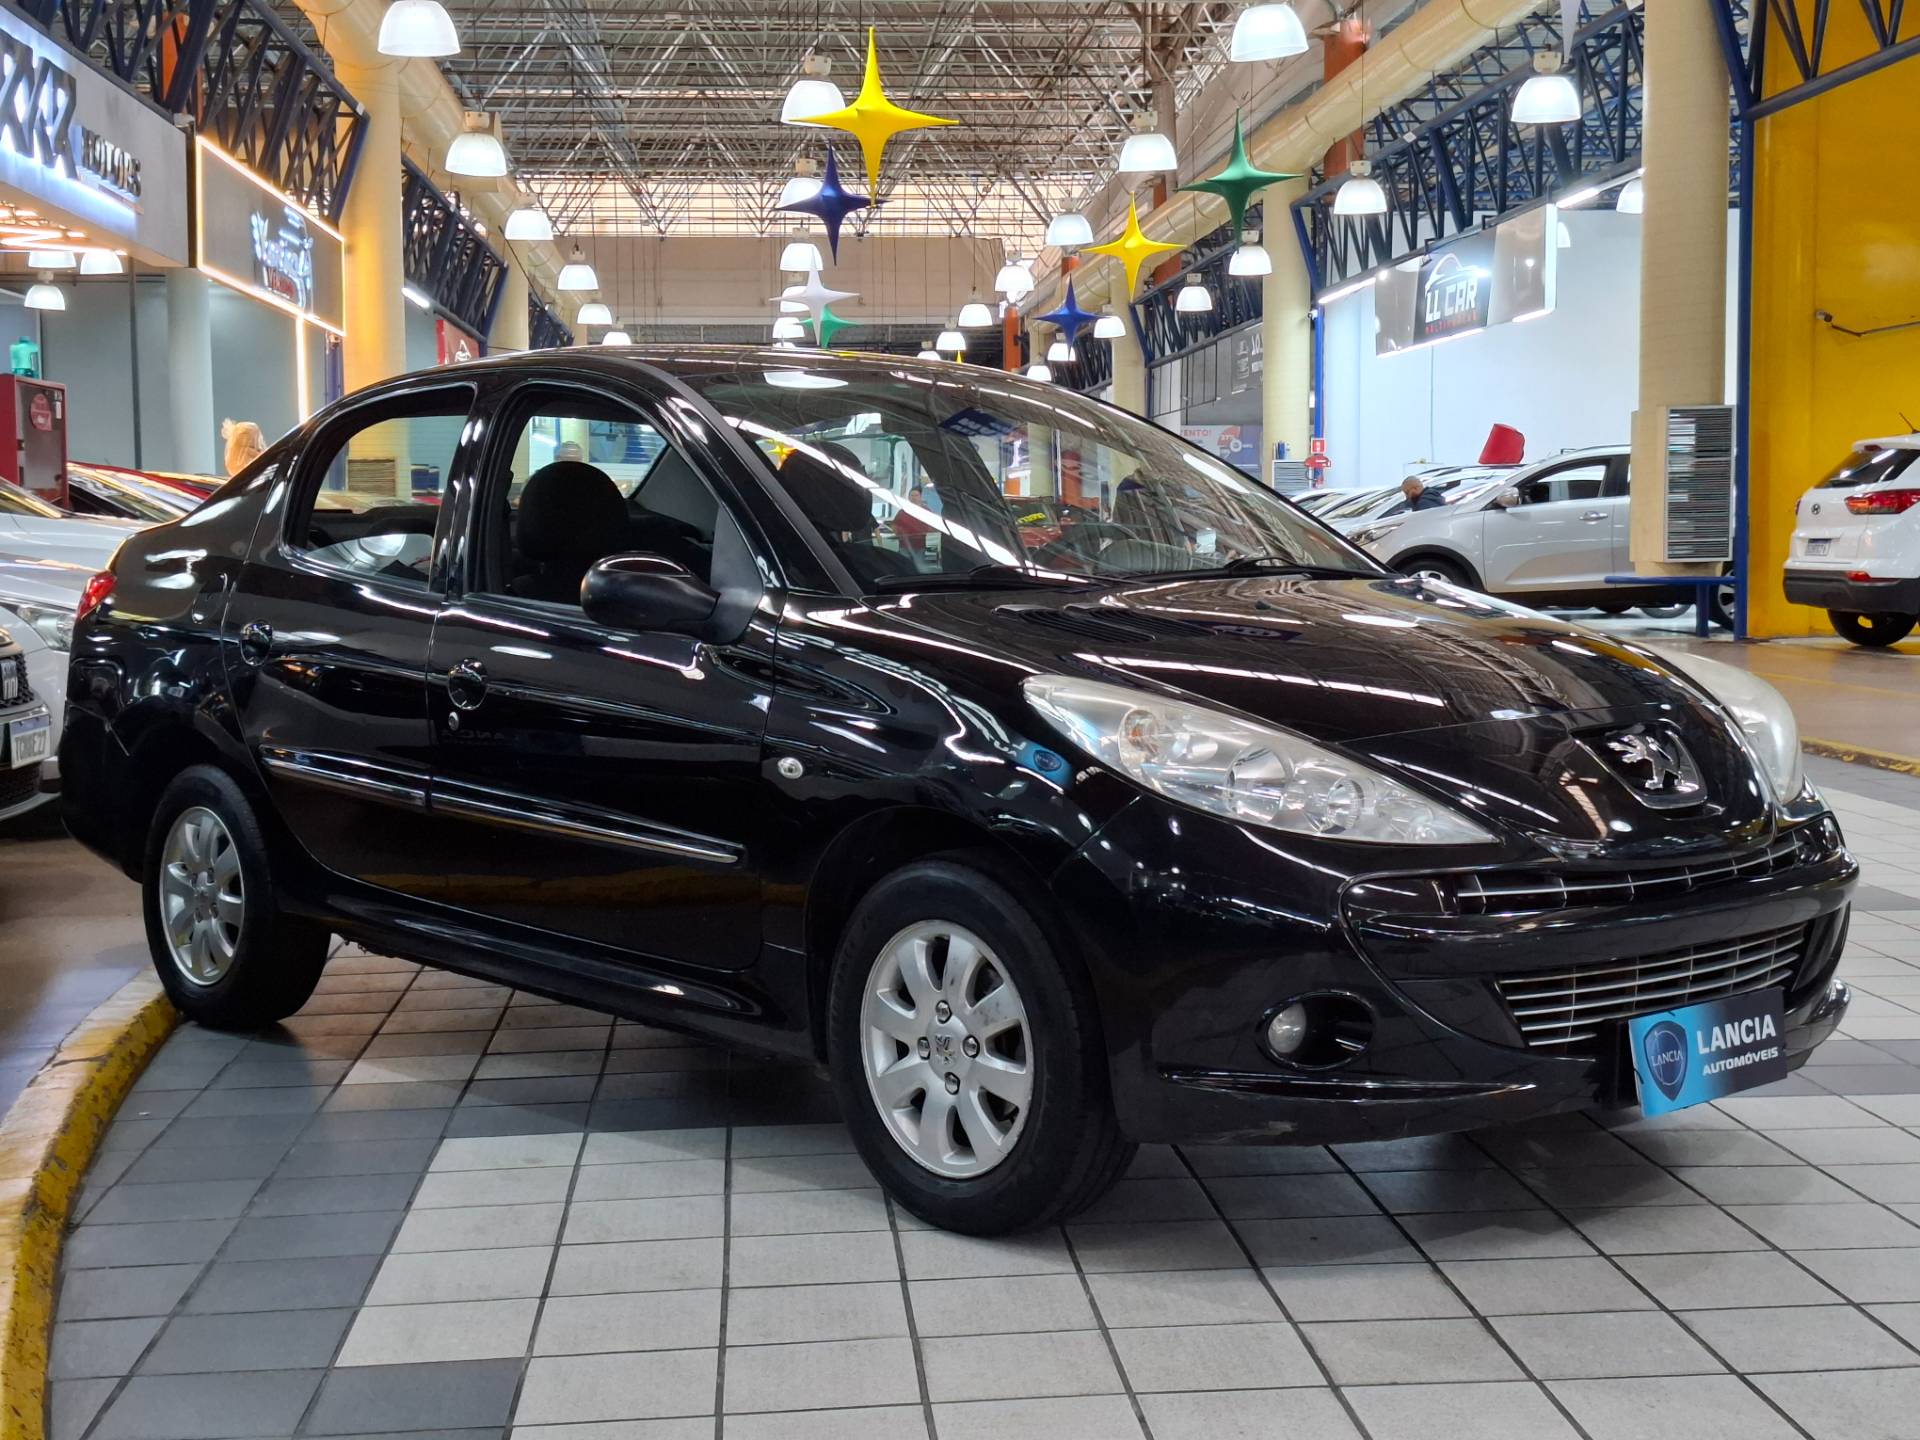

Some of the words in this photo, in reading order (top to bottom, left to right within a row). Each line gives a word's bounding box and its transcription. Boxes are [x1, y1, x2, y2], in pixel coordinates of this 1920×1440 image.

[81, 124, 141, 197] MOTORS
[1445, 279, 1478, 316] CAR
[1696, 1014, 1776, 1055] LANCIA
[1651, 1050, 1684, 1067] LANCIA
[1702, 1046, 1779, 1076] AUTOMÓVEIS
